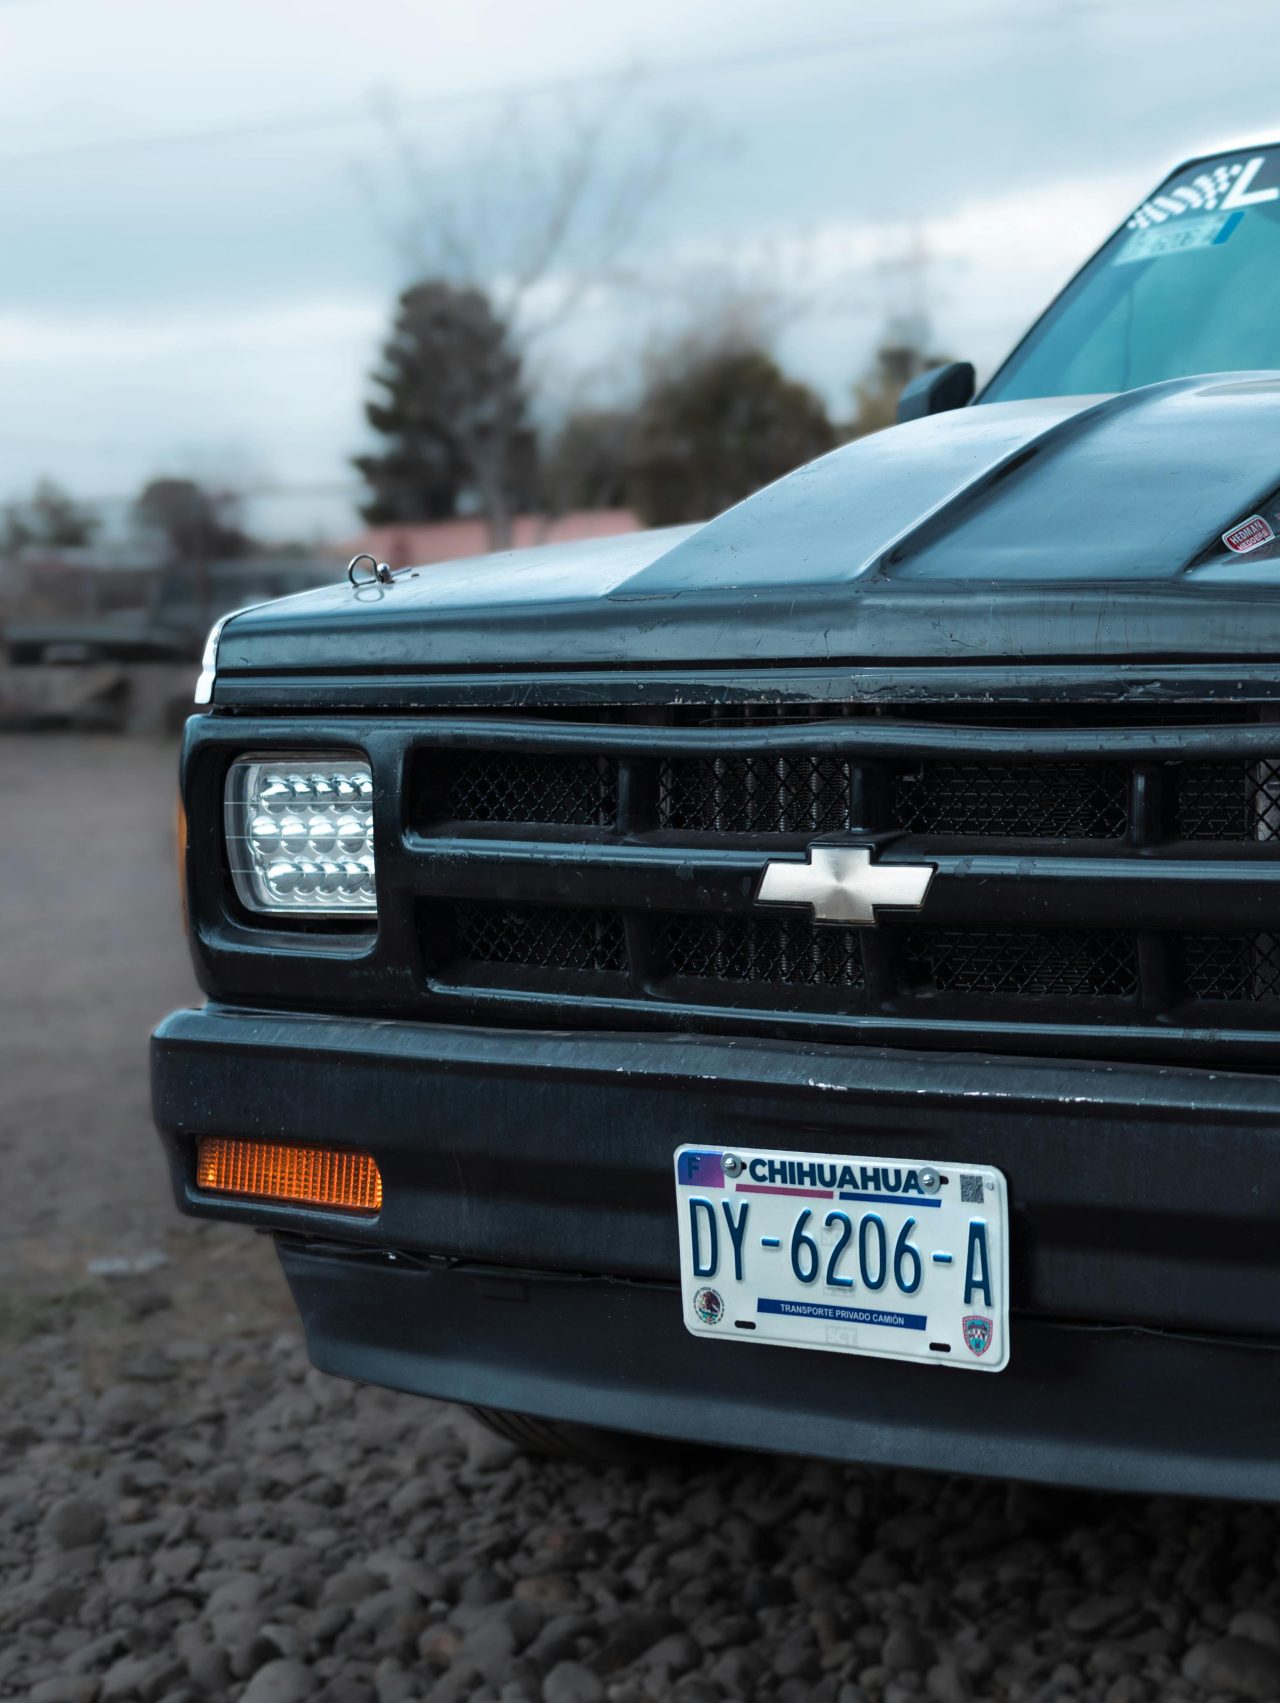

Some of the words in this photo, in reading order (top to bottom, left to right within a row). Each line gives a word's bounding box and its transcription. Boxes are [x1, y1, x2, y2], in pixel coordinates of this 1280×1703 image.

[1229, 520, 1264, 545] HEDMAN
[687, 1156, 701, 1179] F
[749, 1158, 925, 1195] CHIHUAHUA
[689, 1196, 993, 1307] DY-6206-A
[780, 1303, 834, 1318] TRANSPORTE
[835, 1309, 871, 1323] PRIVADO
[873, 1312, 905, 1326] CAMIÓN
